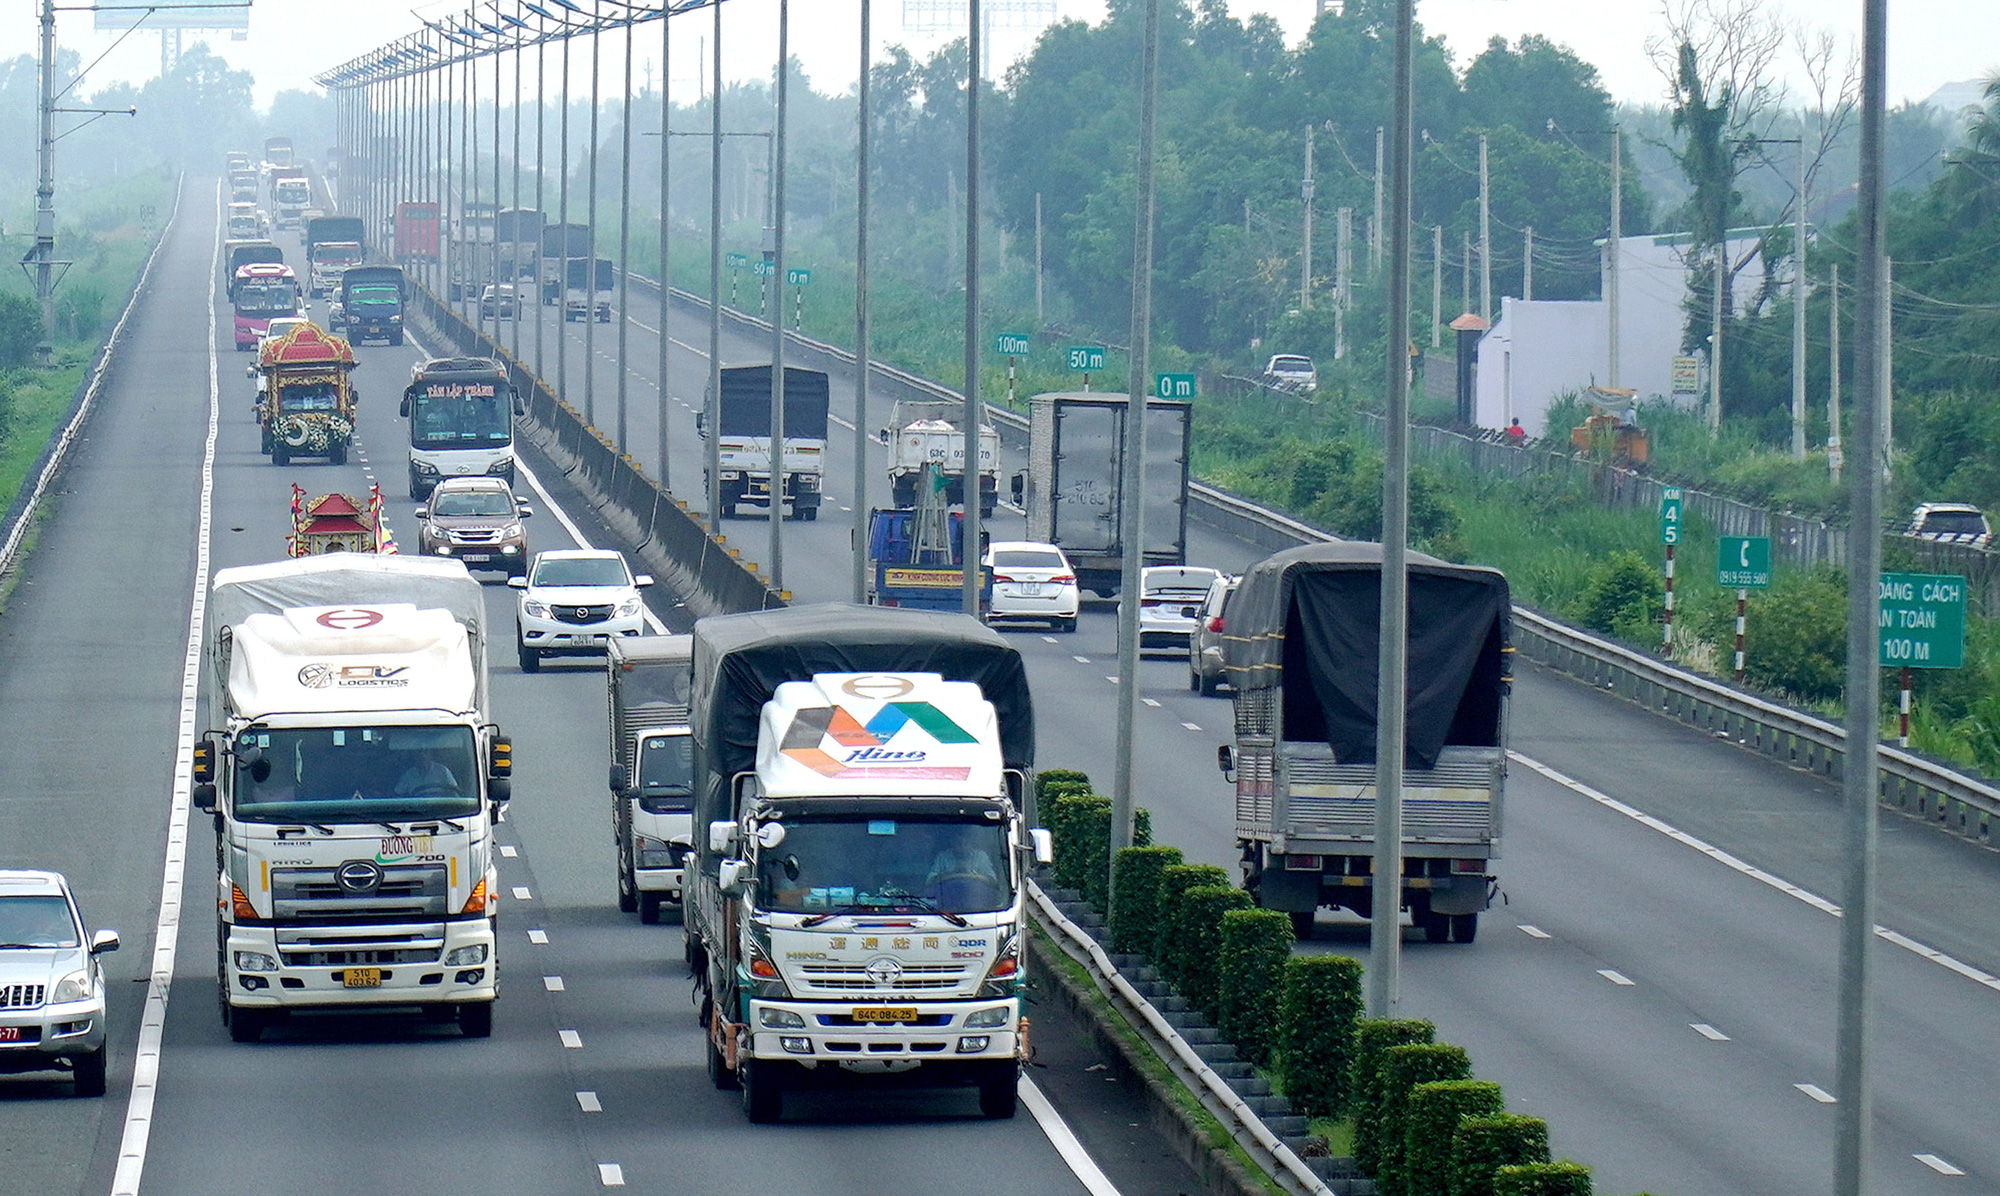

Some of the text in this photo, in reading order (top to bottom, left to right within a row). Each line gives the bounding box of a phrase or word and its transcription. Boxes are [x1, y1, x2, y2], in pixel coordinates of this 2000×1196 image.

[998, 337, 1028, 353] 100m
[1070, 351, 1103, 368] 50 m
[1161, 377, 1190, 396] 0 m
[1664, 489, 1679, 500] KM
[1879, 577, 1959, 603] OẢNG CÁCH
[1898, 606, 1936, 629] TOÀN
[1884, 639, 1930, 660] 100 M
[0, 1027, 18, 1039] -77
